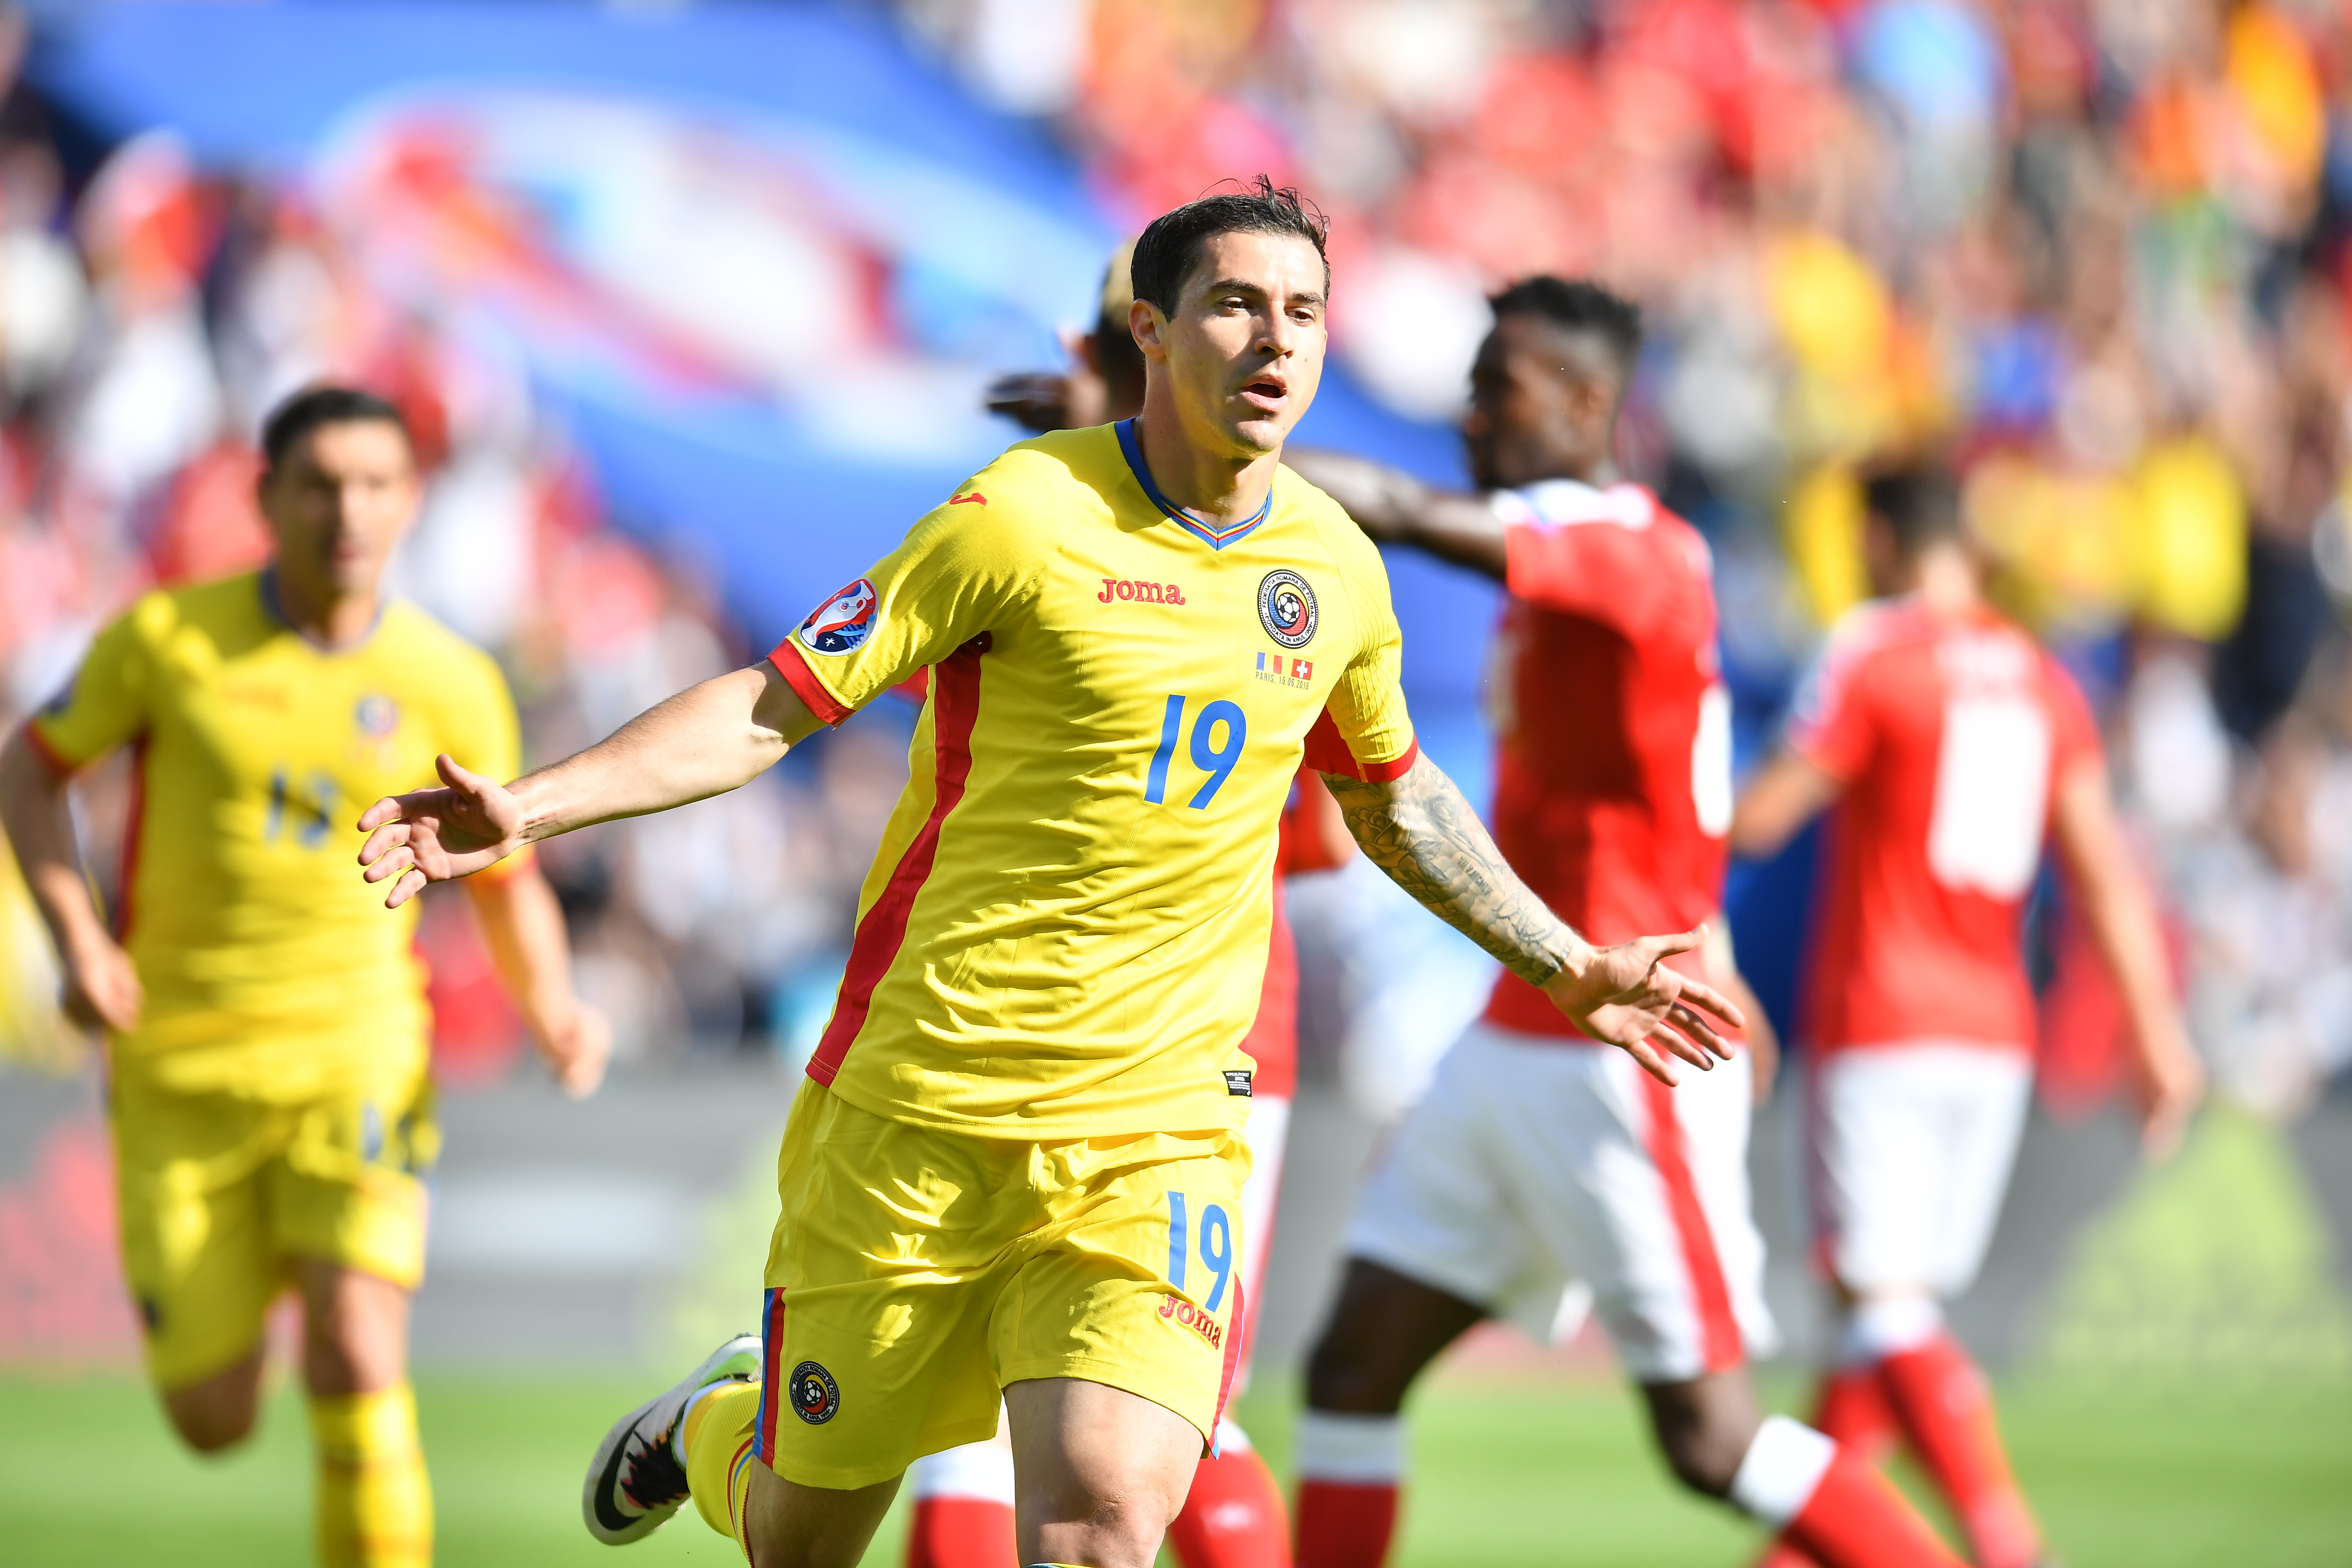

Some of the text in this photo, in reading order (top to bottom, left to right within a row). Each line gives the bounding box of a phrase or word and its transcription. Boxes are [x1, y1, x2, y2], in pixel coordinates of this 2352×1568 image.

[1276, 575, 1298, 585] ROMANA
[1299, 583, 1307, 592] DE
[1306, 592, 1314, 618] FOTBAL
[1264, 615, 1284, 641] FONDATA
[1255, 671, 1309, 690] PARIS, 15.06.2016
[1144, 694, 1246, 810] 19
[1168, 1191, 1232, 1312] 19
